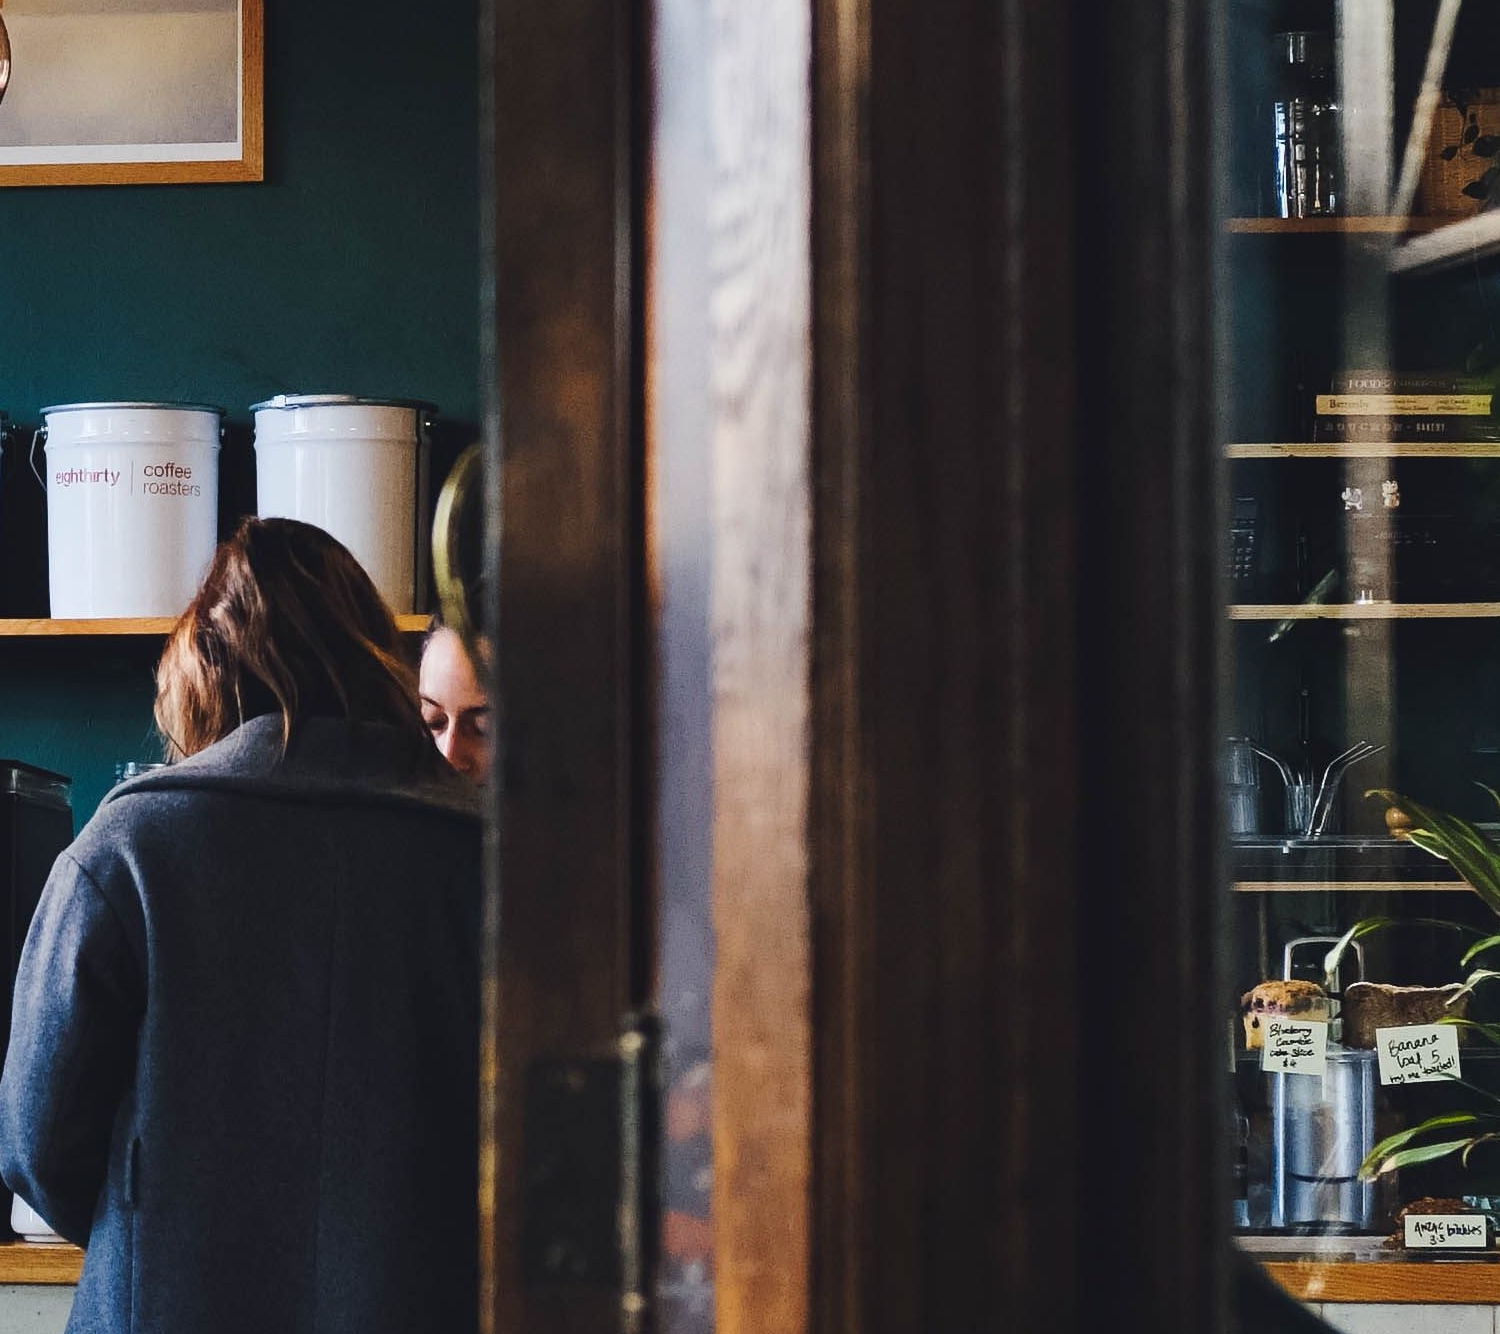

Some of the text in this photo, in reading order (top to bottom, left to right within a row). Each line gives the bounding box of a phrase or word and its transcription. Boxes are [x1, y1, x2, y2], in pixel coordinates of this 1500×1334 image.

[55, 467, 121, 487] eighthirty
[143, 462, 192, 479] coffee
[143, 481, 201, 497] roasters
[1388, 1033, 1440, 1058] Banana
[1431, 1049, 1441, 1065] 5
